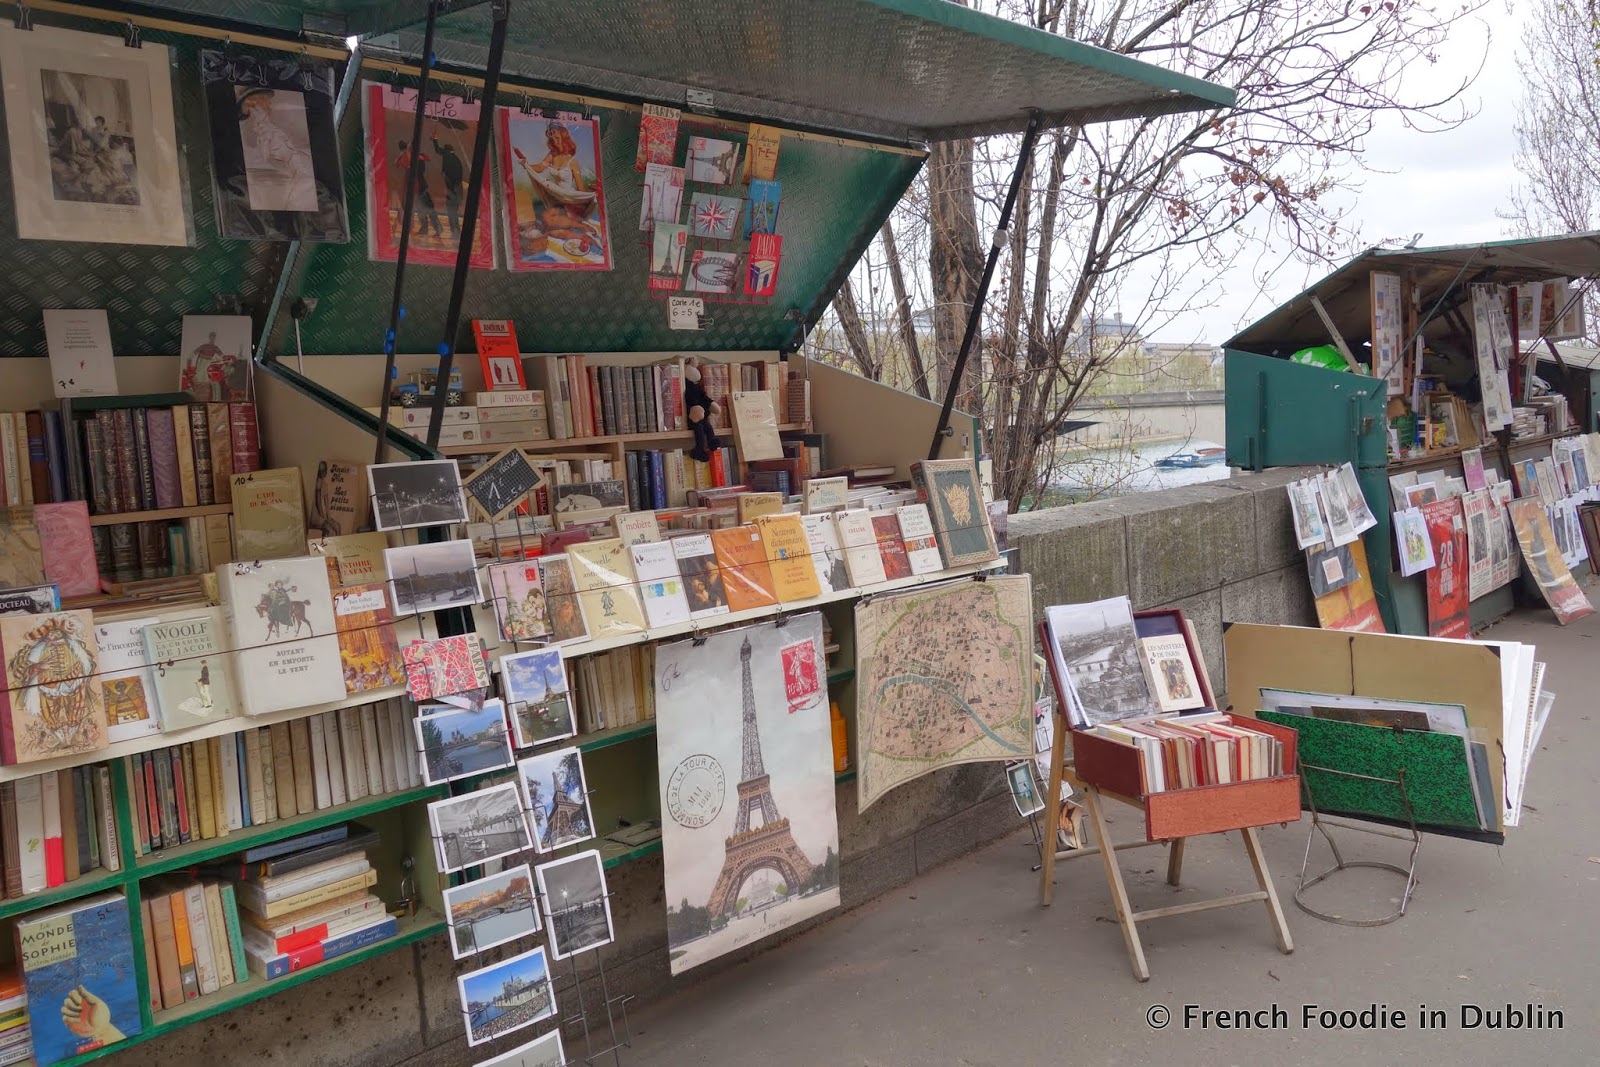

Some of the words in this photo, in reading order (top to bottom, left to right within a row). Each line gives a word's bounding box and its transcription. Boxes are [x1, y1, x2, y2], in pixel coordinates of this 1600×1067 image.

[648, 104, 675, 118] PARIS
[757, 235, 776, 255] PARIS
[504, 394, 530, 403] ESPAGNE
[625, 519, 652, 530] molière
[1440, 540, 1453, 569] 28
[153, 623, 208, 641] WOOLF
[169, 636, 210, 648] CHAMBRE
[158, 650, 173, 658] DE
[177, 642, 213, 655] JACOB
[276, 647, 305, 657] AUTANT
[281, 655, 315, 666] EMPORTE
[468, 641, 487, 680] PARIS
[278, 667, 287, 675] LE
[288, 665, 309, 673] VENT
[683, 758, 706, 770] TOUR
[670, 802, 704, 826] SOMMET
[21, 924, 73, 945] MONDE
[22, 939, 76, 961] SOPHIE
